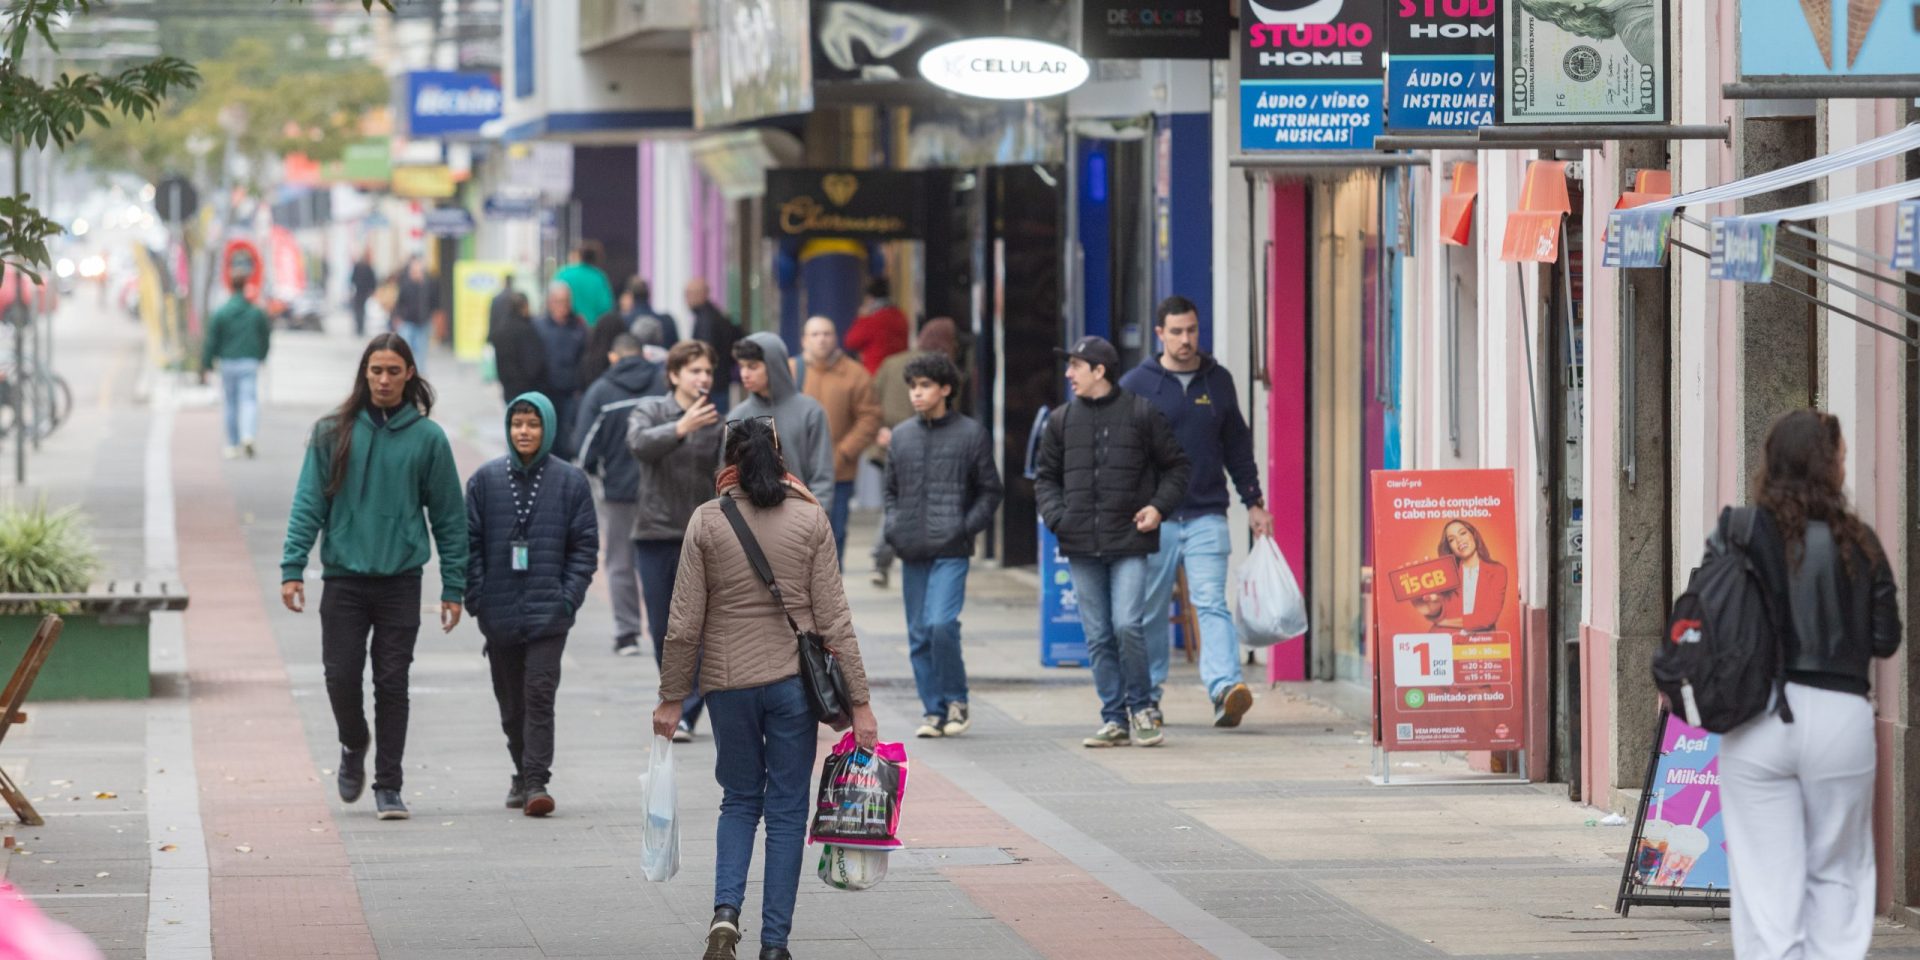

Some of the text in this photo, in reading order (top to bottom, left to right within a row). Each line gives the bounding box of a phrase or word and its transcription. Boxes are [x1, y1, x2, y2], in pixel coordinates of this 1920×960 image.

[1107, 9, 1204, 24] DECOLORES
[1250, 22, 1373, 48] STUDIO
[970, 58, 1068, 74] CELULAR
[1259, 51, 1363, 66] HOME
[1406, 68, 1463, 87] ÁUDIO
[1640, 63, 1654, 106] 100
[1513, 66, 1528, 111] 100
[1256, 91, 1307, 109] ÁUDIO
[1321, 90, 1370, 109] VÍDEO
[1253, 113, 1370, 127] INSTRUMENTOS
[1275, 128, 1349, 142] MUSICAIS
[1393, 495, 1501, 508] O Prezão é completão
[1394, 507, 1492, 519] e cabe no seu bolso.
[1399, 642, 1431, 676] R$ 1
[1433, 659, 1447, 668] por
[1433, 667, 1446, 676] dia
[1428, 692, 1504, 704] ilimitado pra tudo
[1674, 734, 1710, 753] Açaí
